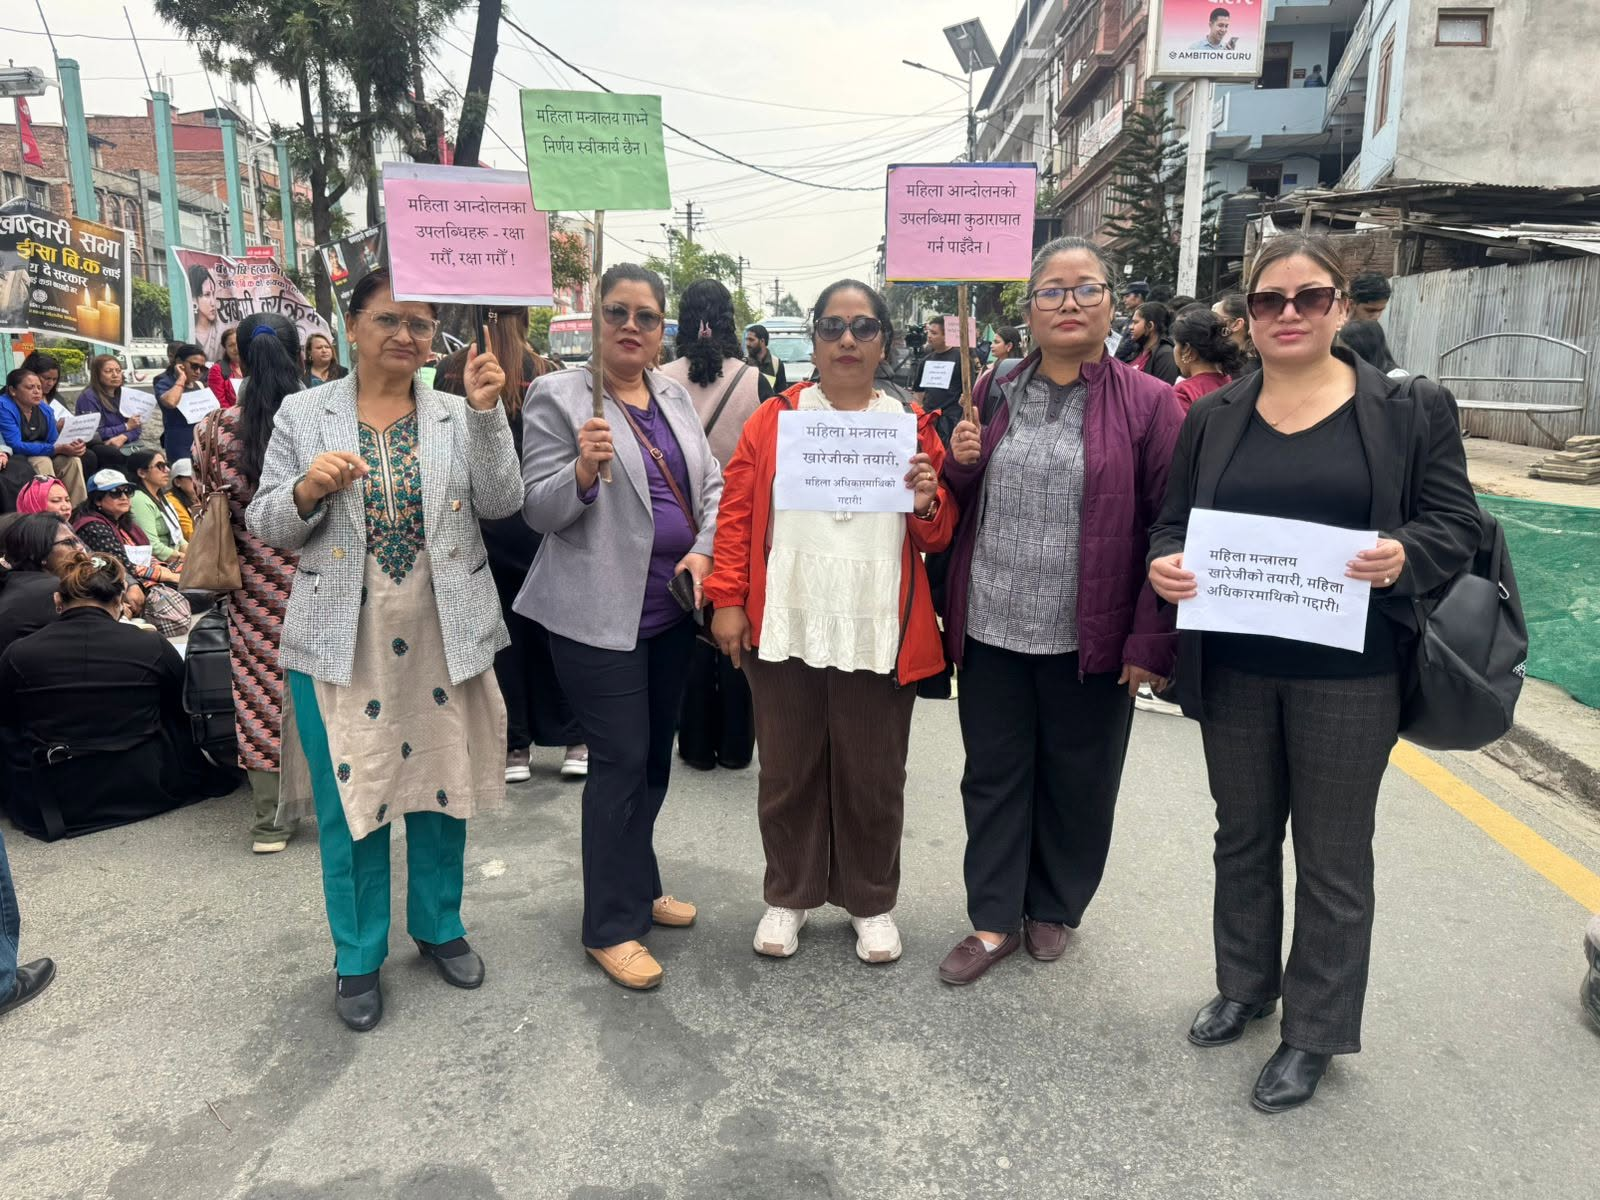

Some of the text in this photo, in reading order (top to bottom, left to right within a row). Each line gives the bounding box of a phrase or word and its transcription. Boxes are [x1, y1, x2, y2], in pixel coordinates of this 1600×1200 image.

[1178, 52, 1251, 60] AMBITION GURU
[536, 104, 572, 125] महिला
[576, 110, 620, 126] मन्त्रालय
[543, 134, 573, 155] निर्णय
[577, 136, 620, 155] स्वीकार्य
[907, 180, 1016, 198] महिला आन्दोलनको
[408, 194, 526, 215] महिला आन्दोलनका
[899, 208, 1021, 232] उपलब्धिमा कुठाराघात
[502, 227, 525, 240] रक्षा
[79, 231, 121, 259] सभा
[928, 236, 943, 253] गर्न
[459, 252, 482, 265] रक्षा
[53, 269, 88, 287] सरकार
[806, 422, 898, 439] महिला मन्त्रालय
[803, 448, 859, 465] खारेजीको
[805, 476, 896, 488] महिला अधिकारमाथिको
[1209, 547, 1298, 567] महिला मन्त्रालय
[1208, 566, 1263, 583] खारेजीको
[1307, 577, 1344, 594] महिला
[1207, 584, 1299, 605] अधिकारमाथिको
